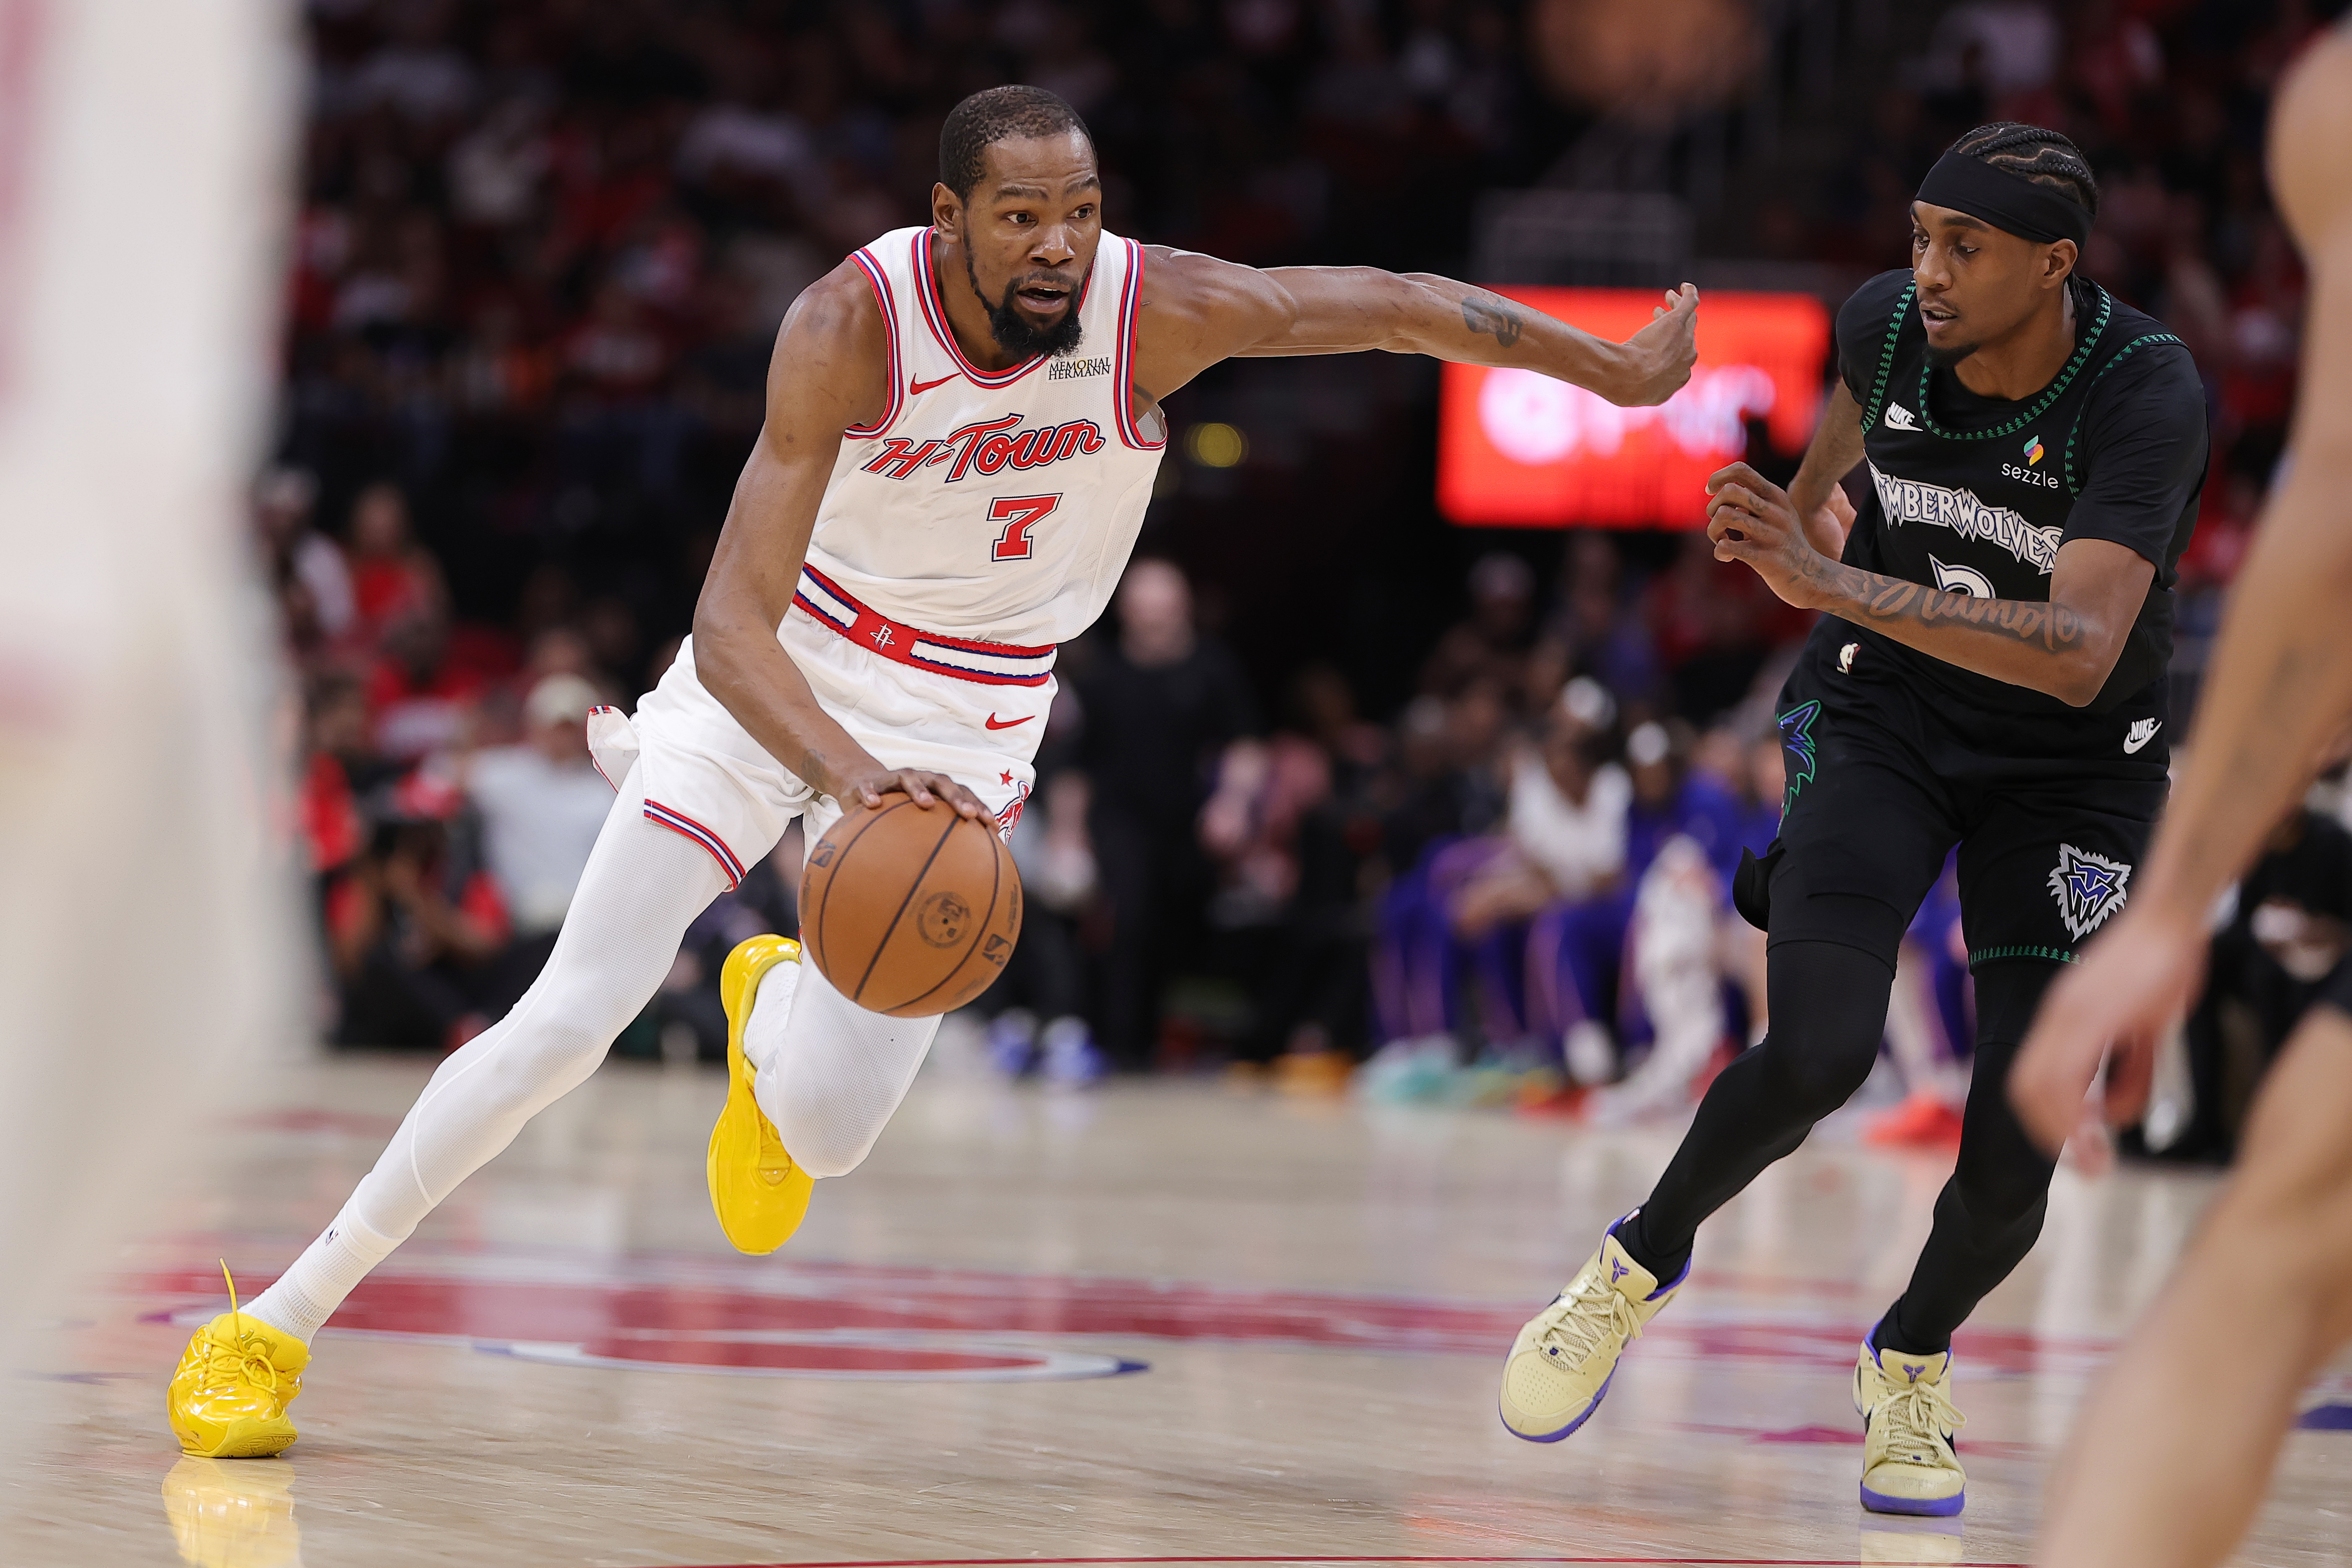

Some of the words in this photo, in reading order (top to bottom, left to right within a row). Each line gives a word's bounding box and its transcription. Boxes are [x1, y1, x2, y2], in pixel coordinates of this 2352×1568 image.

[1048, 366, 1110, 380] HERMANN
[1049, 357, 1111, 372] MEMORIAL
[1888, 401, 1915, 425] NIKE
[860, 413, 1106, 483] H-Town
[2001, 463, 2059, 489] sezzle
[986, 493, 1063, 562] 7
[2130, 717, 2155, 741] NIKE
